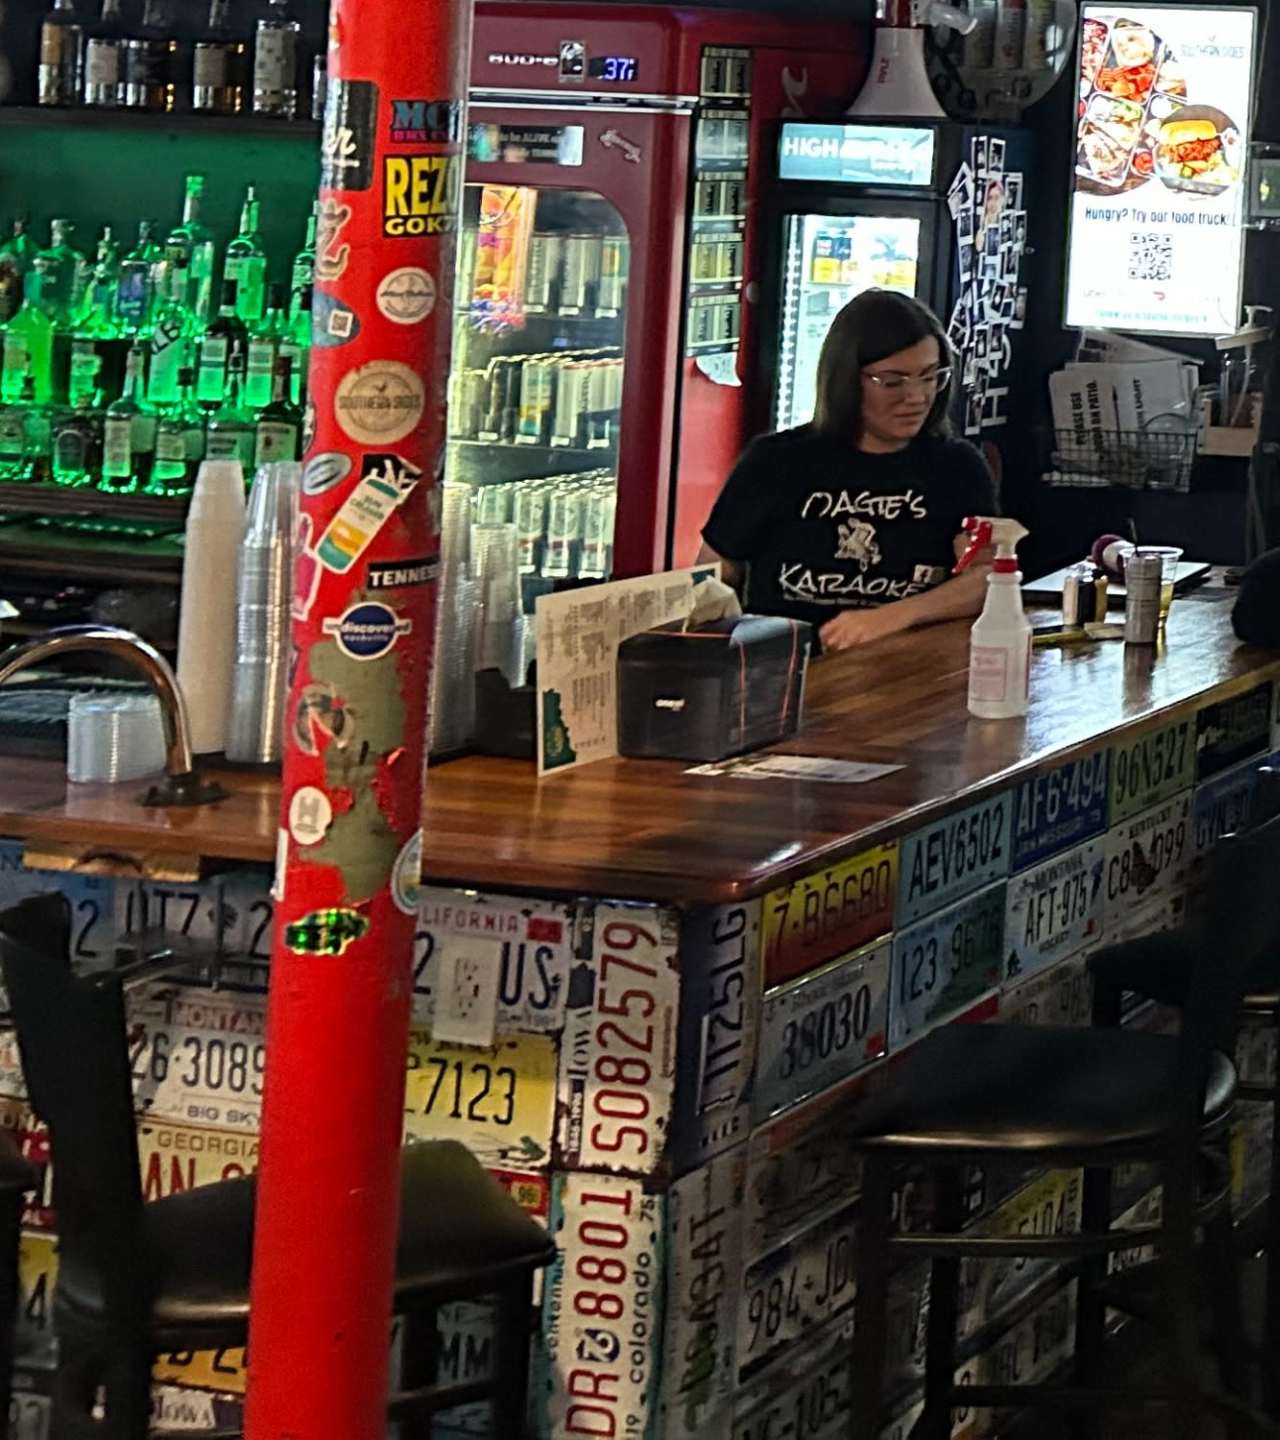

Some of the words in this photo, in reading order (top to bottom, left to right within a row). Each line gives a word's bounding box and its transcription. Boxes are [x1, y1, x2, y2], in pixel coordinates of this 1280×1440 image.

[783, 136, 840, 158] HIGH
[778, 563, 924, 599] KARAOKE
[1115, 721, 1189, 805] 96N527
[908, 807, 1005, 903] AEV6502
[500, 941, 560, 1011] US
[172, 1000, 264, 1036] MONTAN
[187, 1105, 219, 1120] BIG
[425, 1058, 516, 1125] 7123
[157, 1129, 259, 1158] GEORGIA
[628, 1252, 653, 1384] colorado
